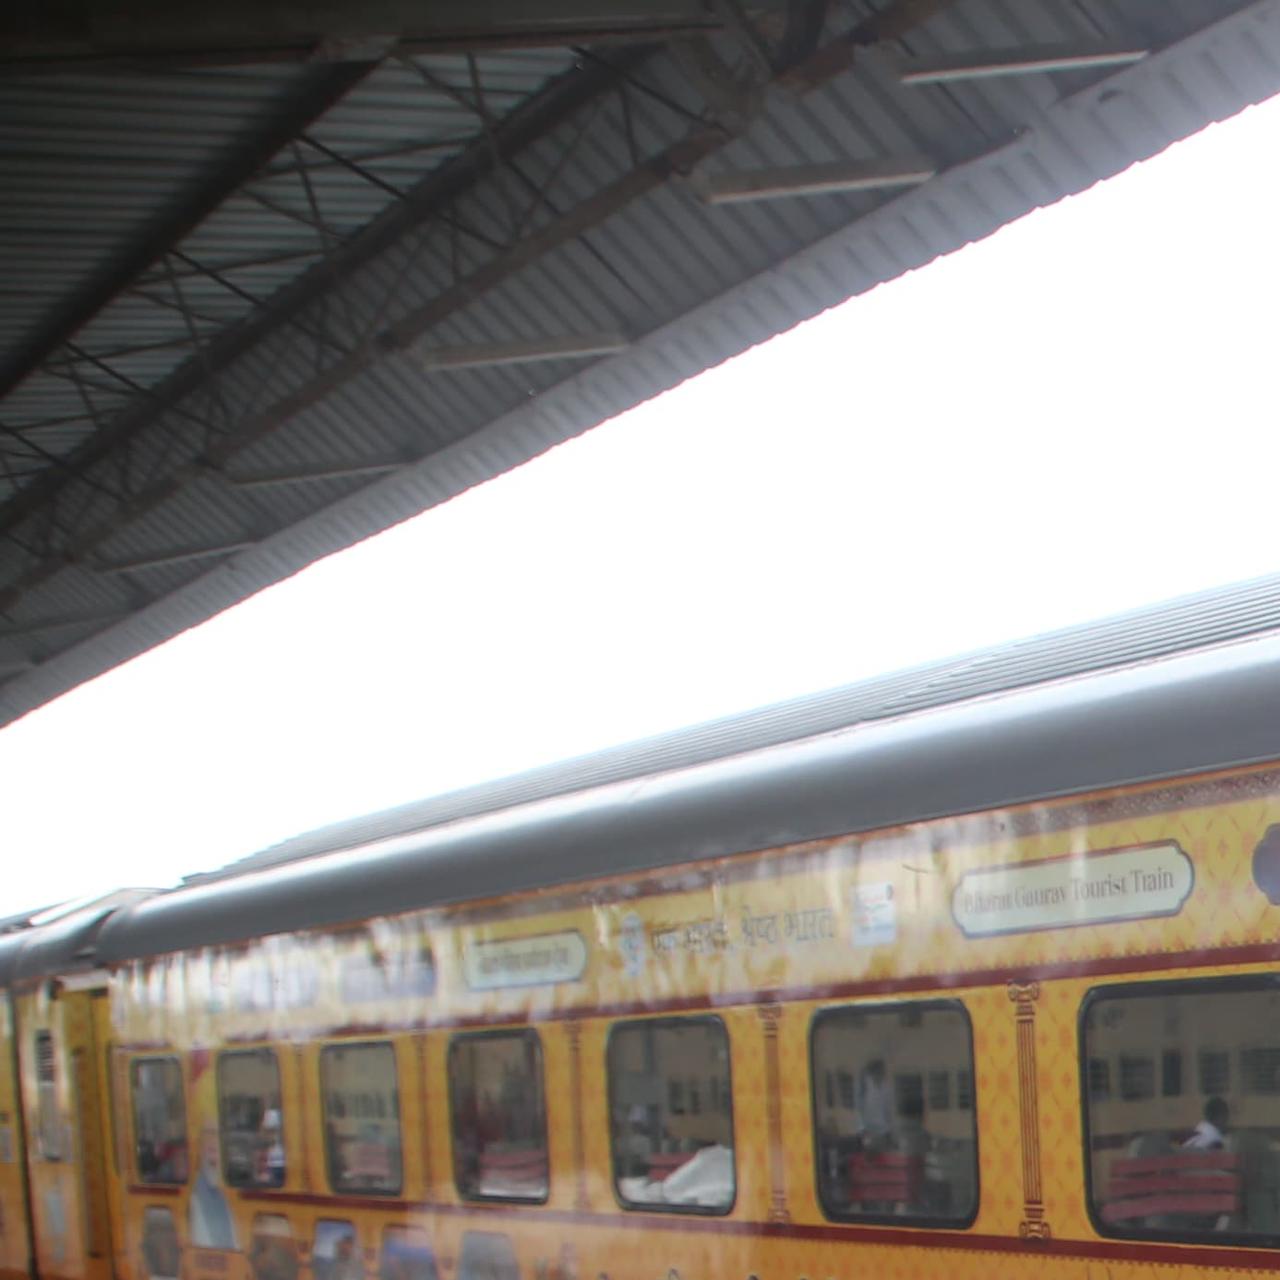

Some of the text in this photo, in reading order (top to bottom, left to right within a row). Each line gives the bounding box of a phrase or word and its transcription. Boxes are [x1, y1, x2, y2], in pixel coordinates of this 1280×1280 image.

[1014, 886, 1066, 909] Gaurav
[1071, 873, 1127, 899] Tourist
[1130, 866, 1175, 892] Train
